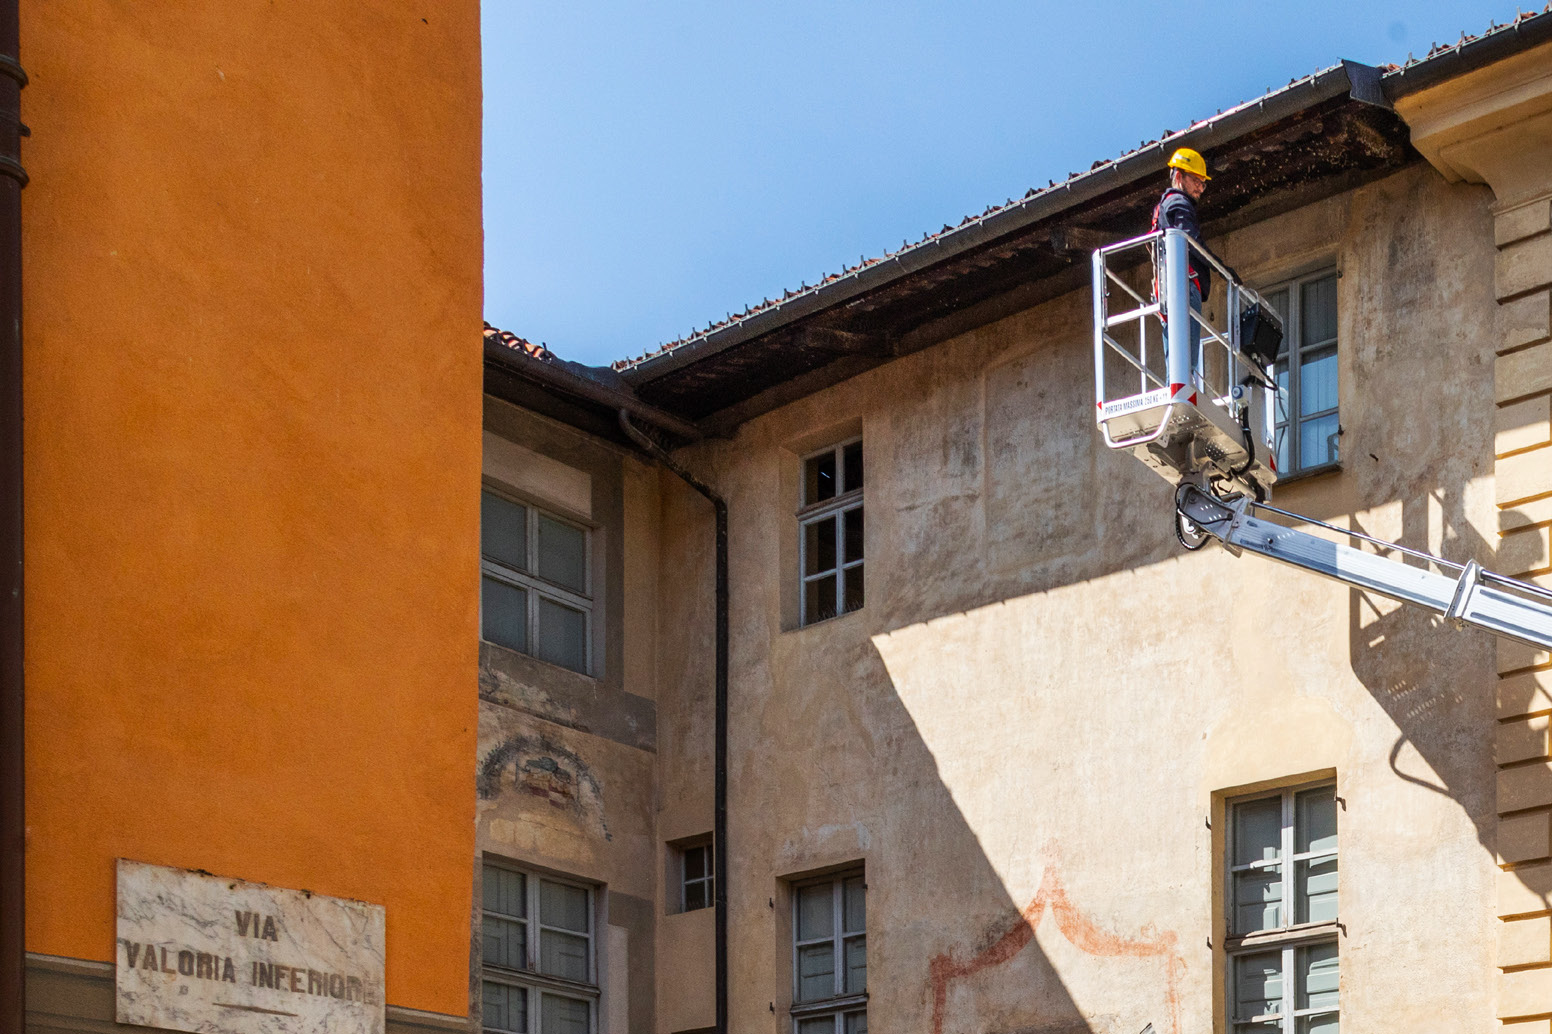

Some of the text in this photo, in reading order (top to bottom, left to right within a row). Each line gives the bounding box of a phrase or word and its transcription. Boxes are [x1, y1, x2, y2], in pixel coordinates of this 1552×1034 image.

[234, 909, 278, 942] VIA
[123, 939, 380, 1006] VALORIA INFERIORE
